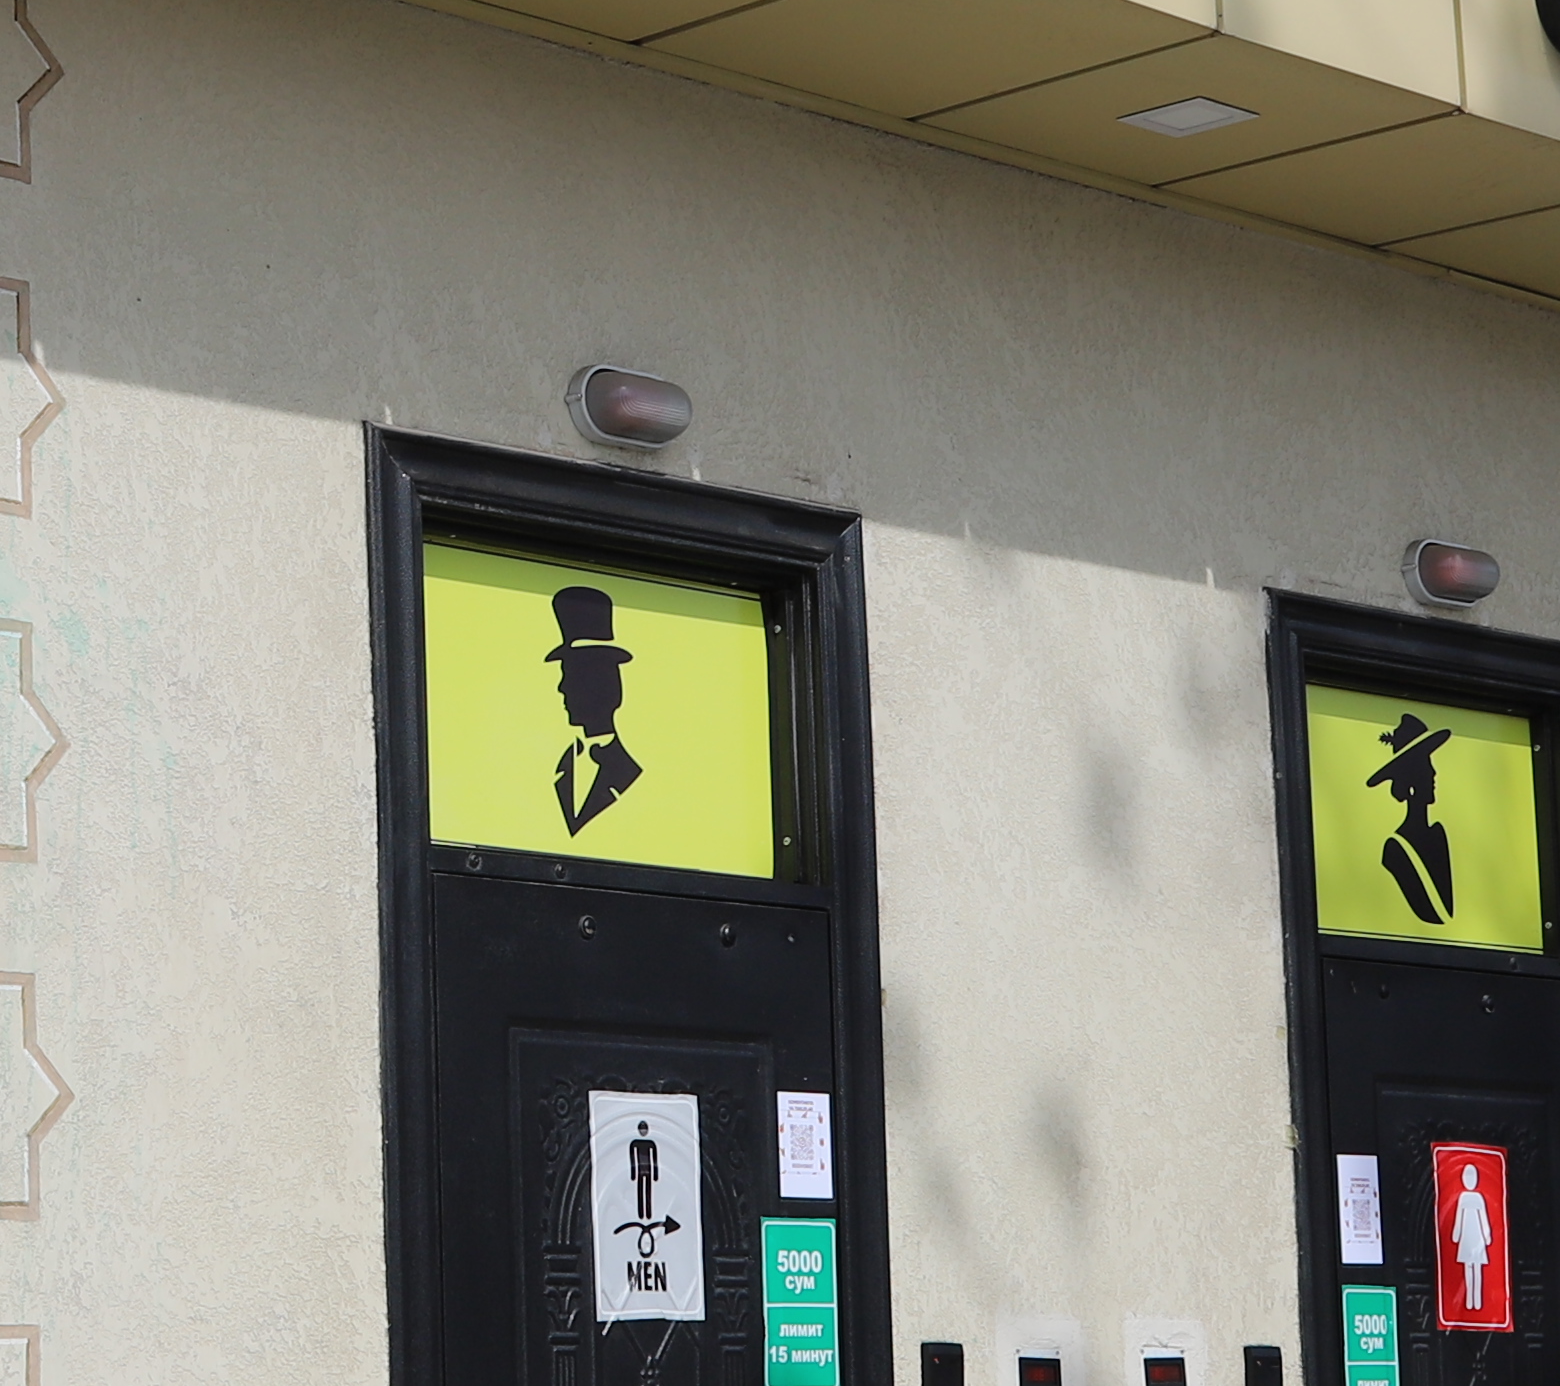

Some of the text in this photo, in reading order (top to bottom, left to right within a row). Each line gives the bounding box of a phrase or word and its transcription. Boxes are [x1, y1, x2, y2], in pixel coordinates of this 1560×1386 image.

[776, 1249, 823, 1274] 5000
[627, 1261, 668, 1293] MEN
[785, 1275, 815, 1295] сум
[1354, 1314, 1388, 1335] 5000
[1360, 1336, 1384, 1354] сум
[768, 1347, 834, 1367] 15 минут
